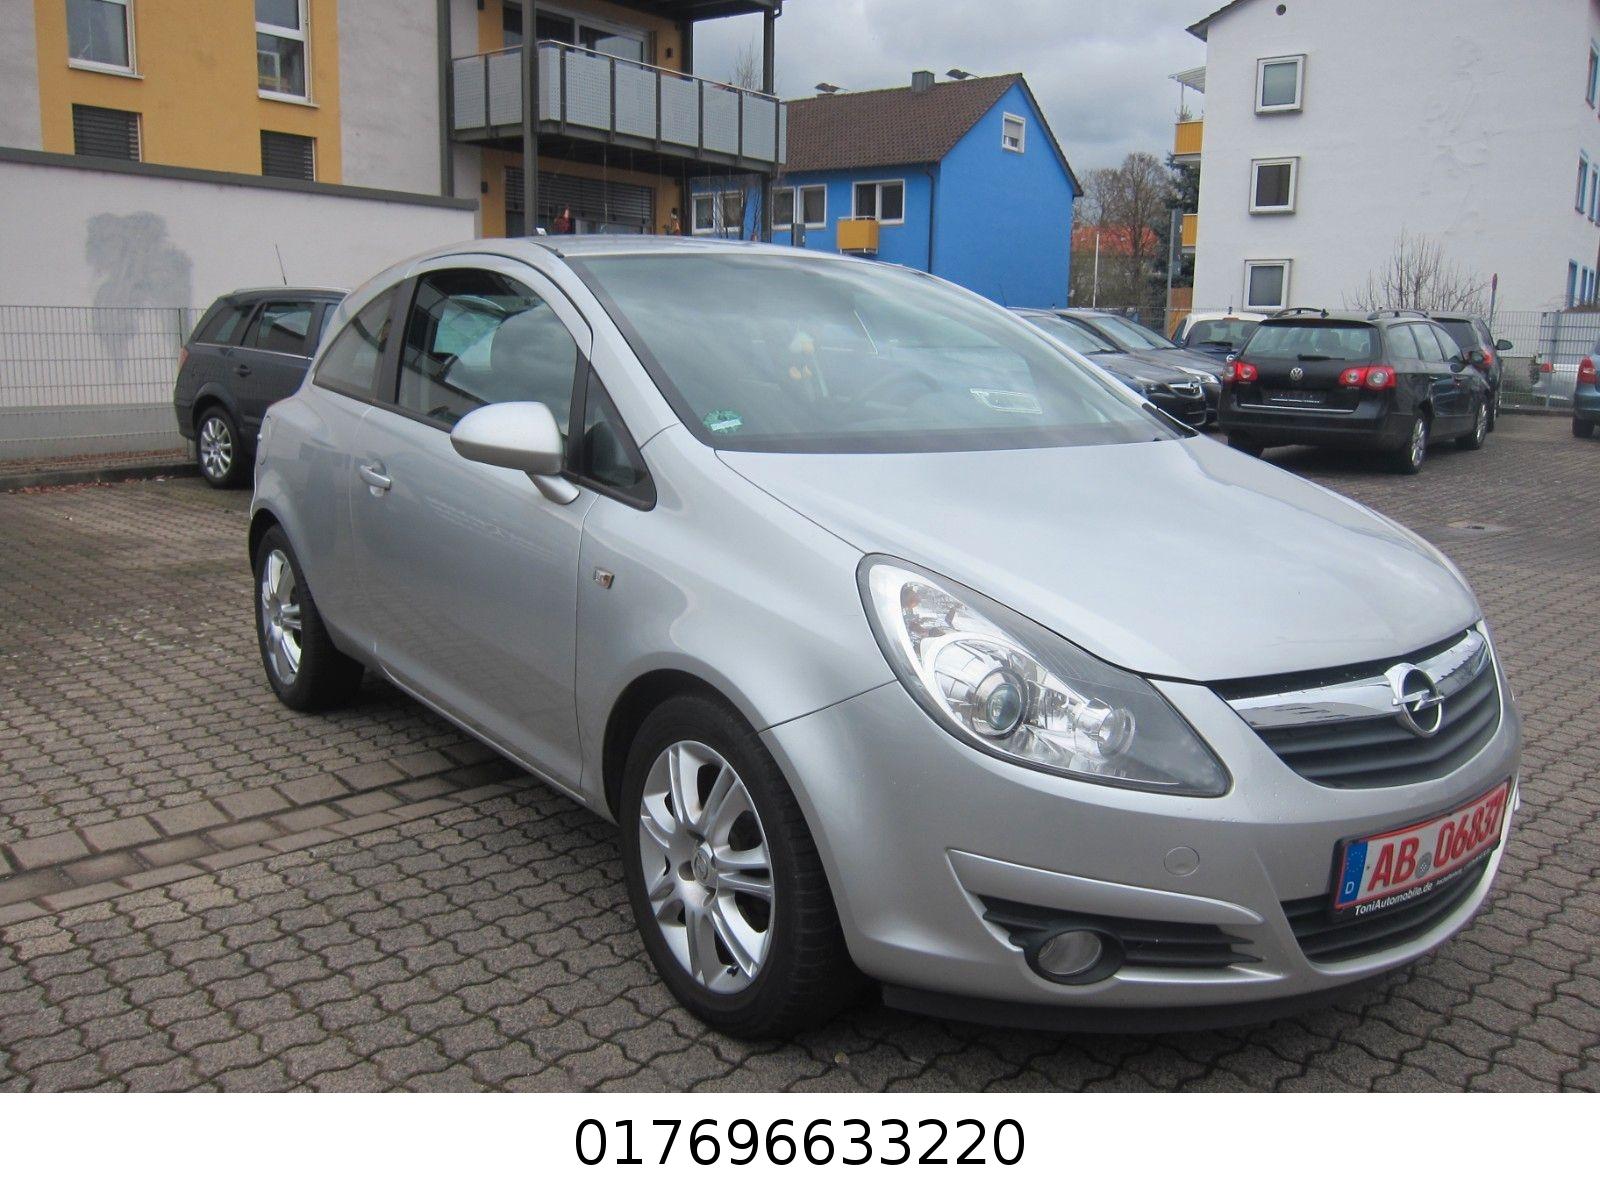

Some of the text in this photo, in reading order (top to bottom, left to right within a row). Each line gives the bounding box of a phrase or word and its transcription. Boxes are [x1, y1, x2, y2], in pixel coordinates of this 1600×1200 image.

[1367, 837, 1420, 892] AB
[1344, 881, 1355, 895] D
[1355, 882, 1433, 915] ToniAutomobile.de
